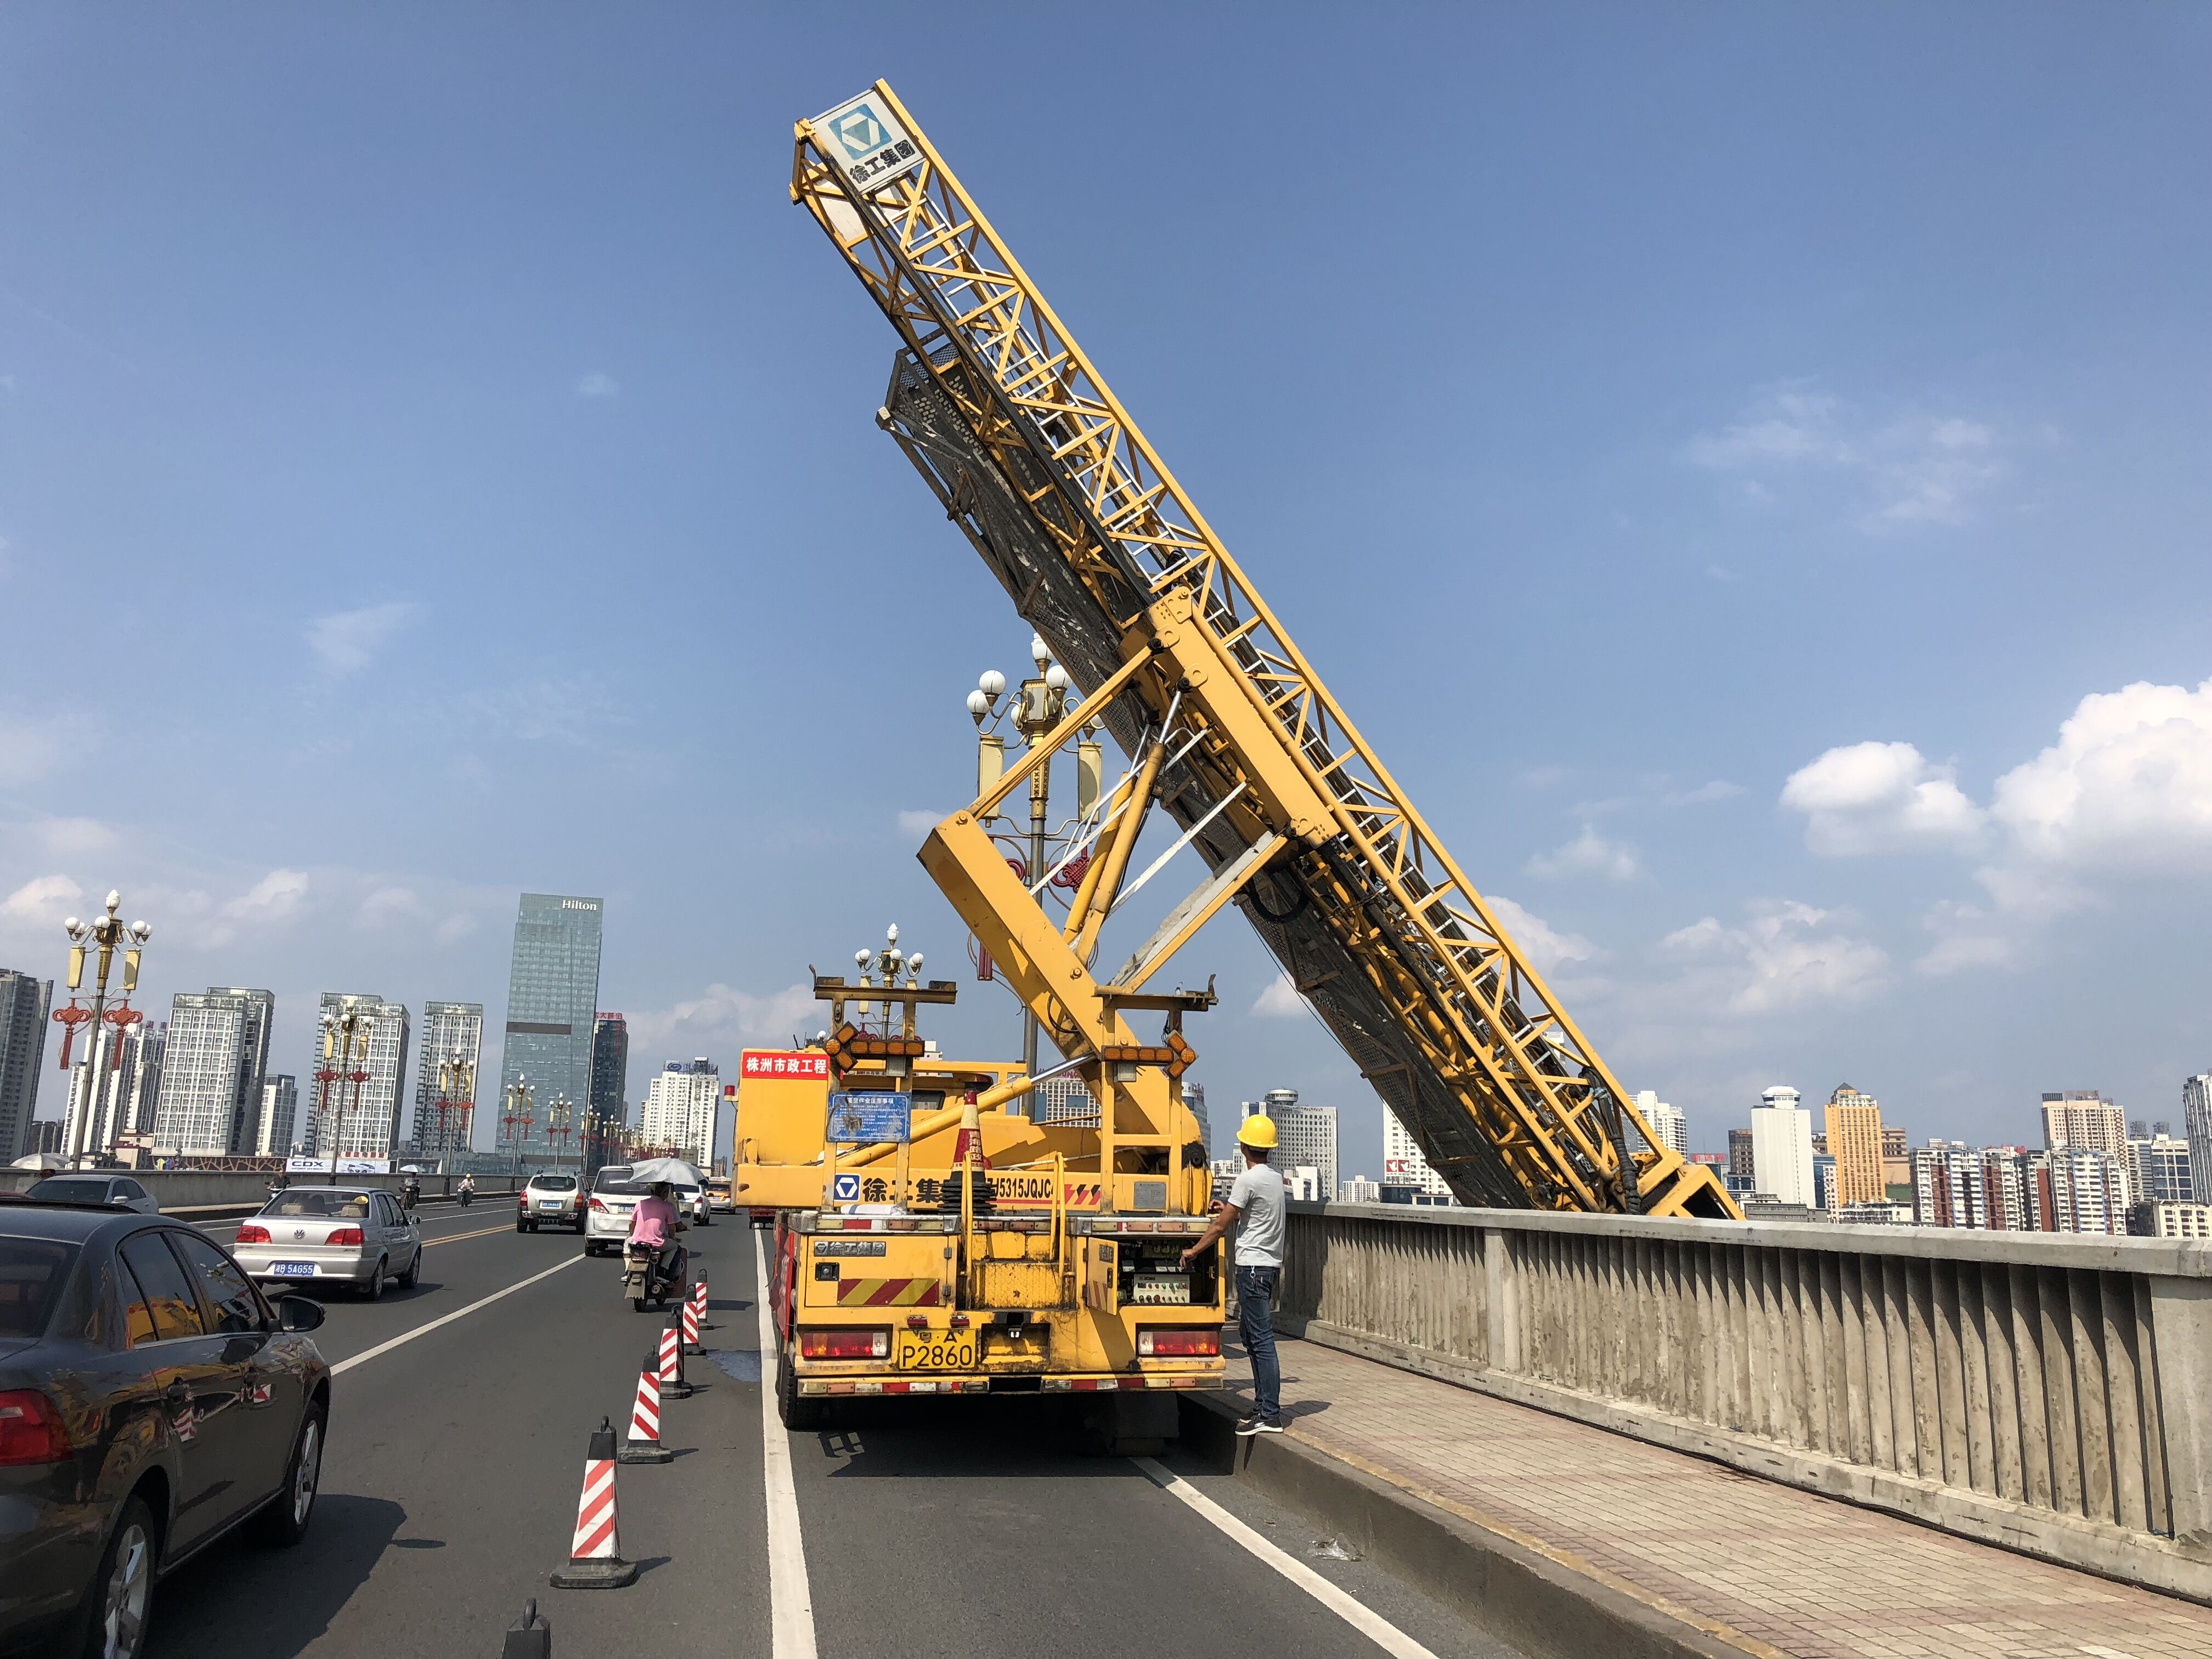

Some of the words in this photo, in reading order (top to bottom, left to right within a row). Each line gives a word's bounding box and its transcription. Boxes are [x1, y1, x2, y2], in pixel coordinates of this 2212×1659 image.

[849, 139, 916, 184] 徐工集团
[562, 900, 597, 911] Hilton
[746, 1057, 827, 1074] 株洲市政工程
[986, 1177, 1053, 1199] J5315JQJC
[829, 1242, 885, 1256] 徐工集团
[902, 1345, 972, 1367] P2860
